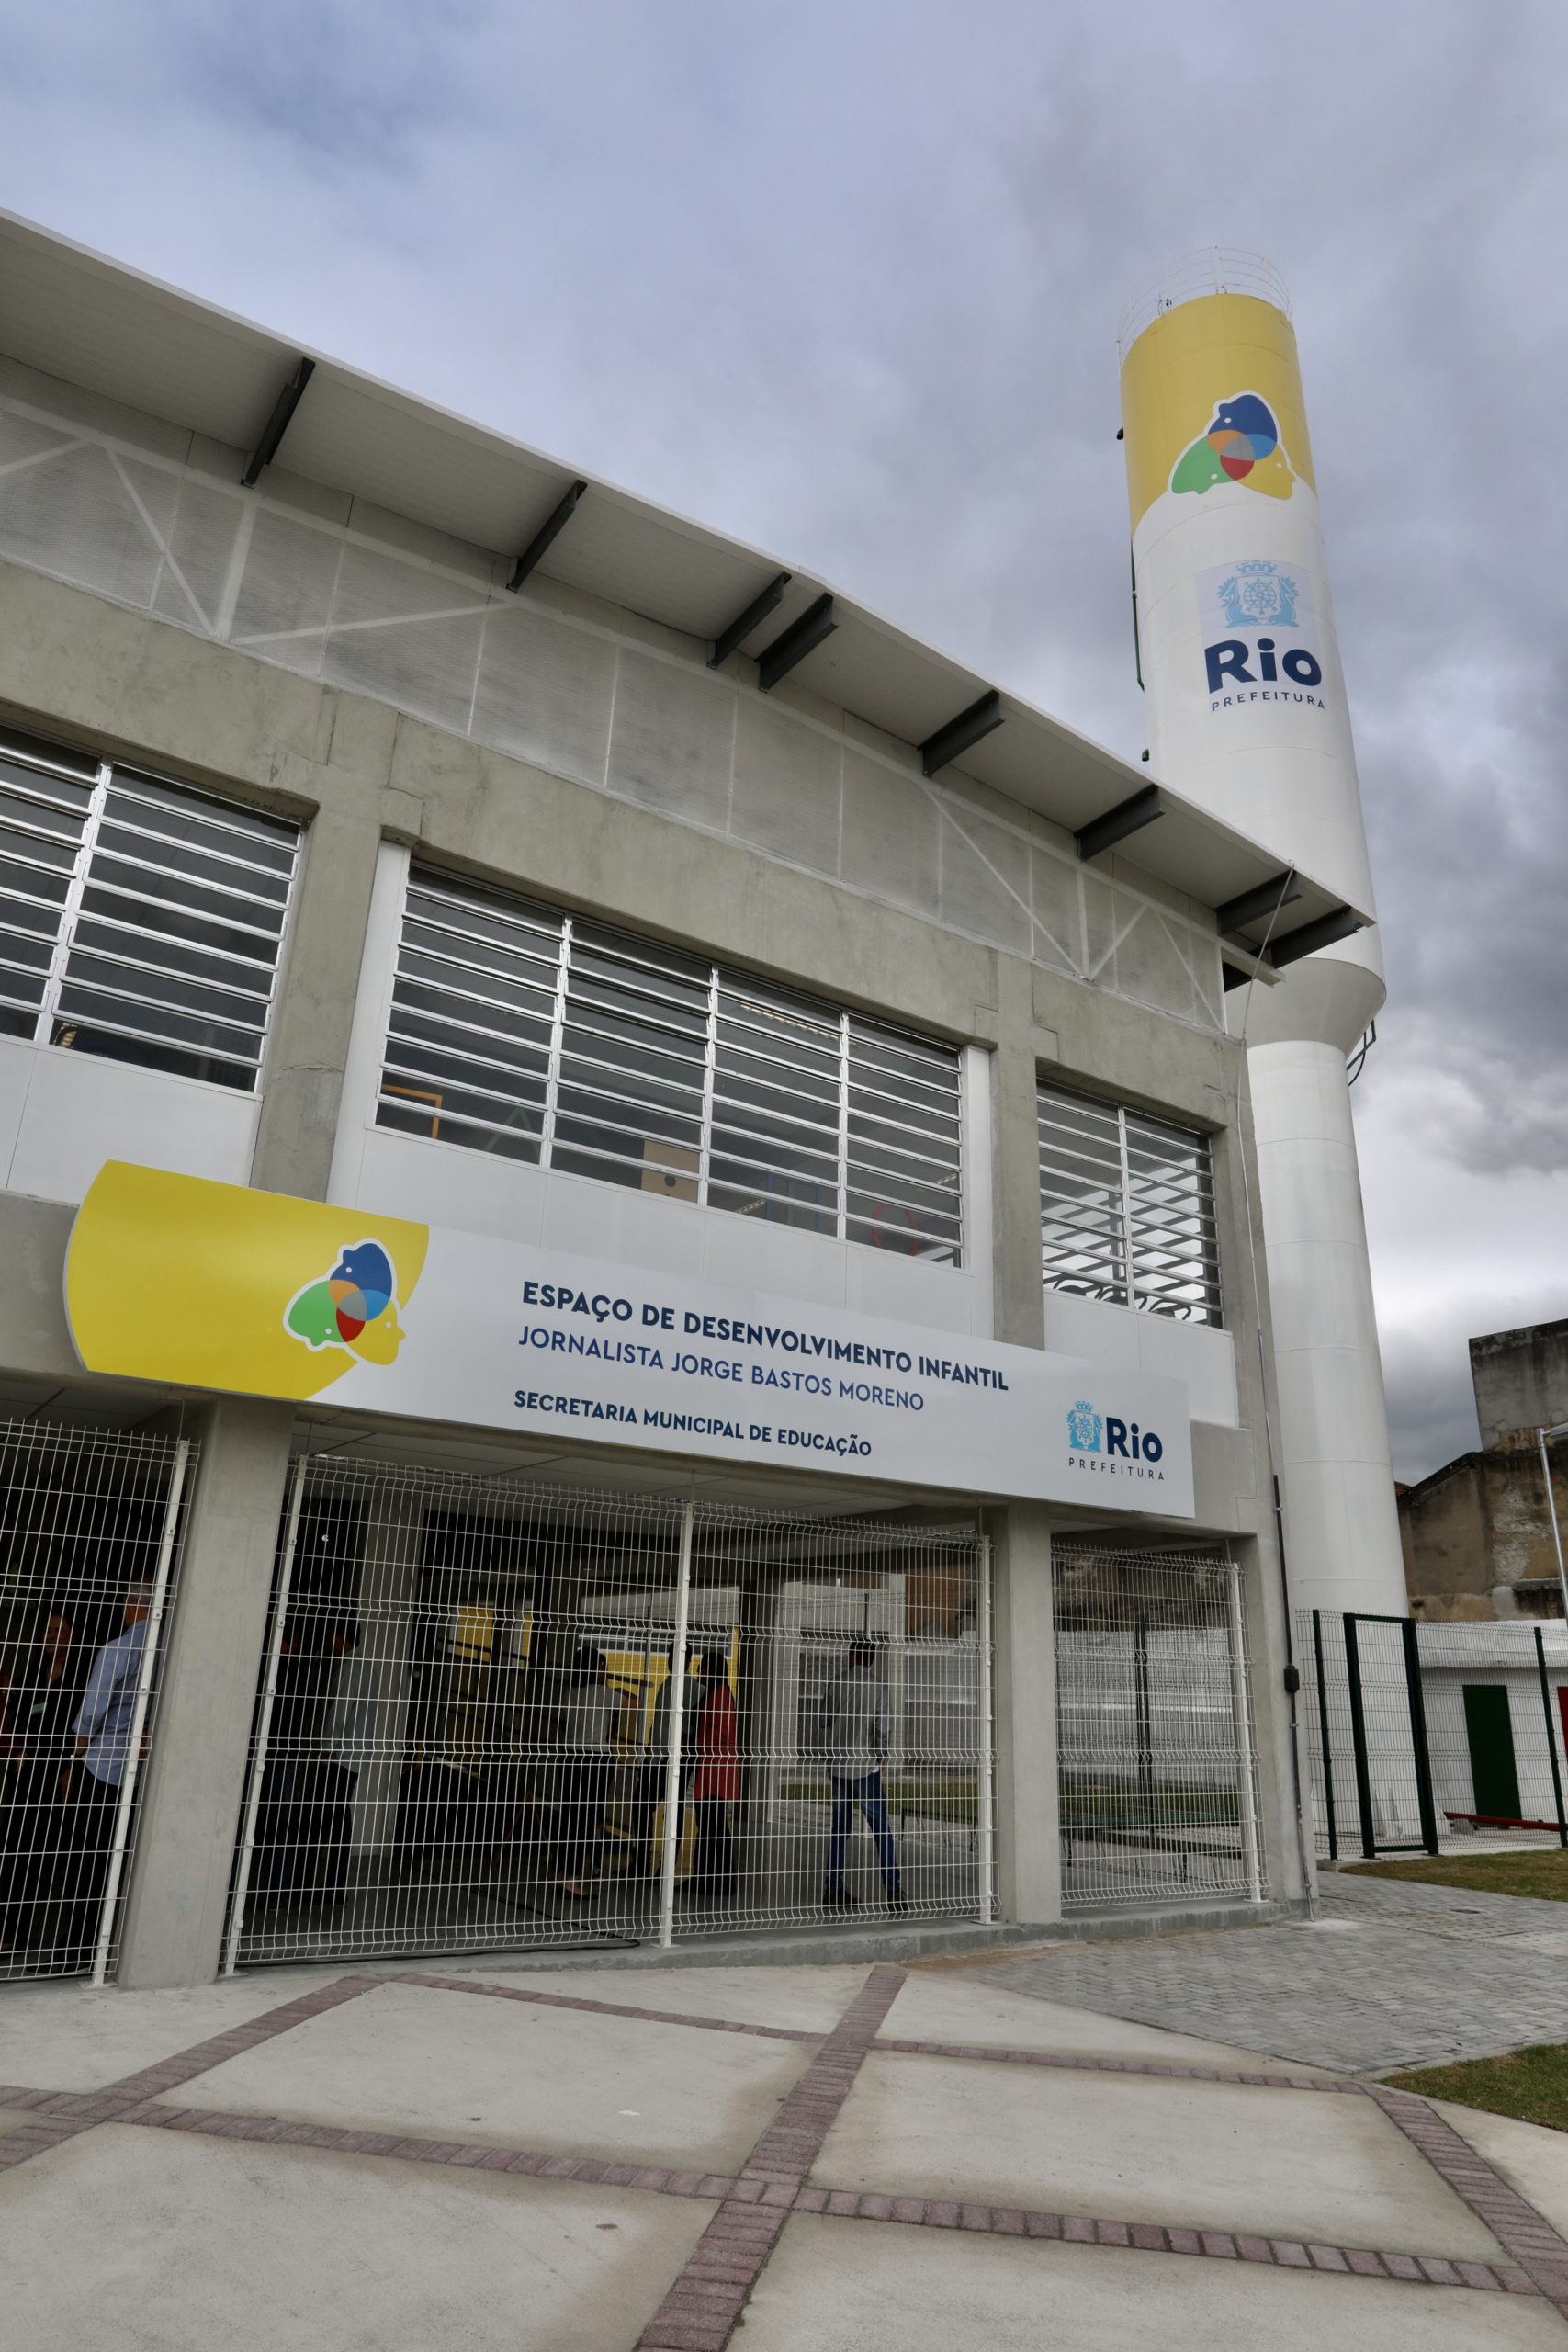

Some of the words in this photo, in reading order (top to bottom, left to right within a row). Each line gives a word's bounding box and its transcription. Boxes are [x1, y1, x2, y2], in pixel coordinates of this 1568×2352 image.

[1204, 638, 1323, 695] Rio
[1212, 691, 1325, 712] PREFEITURA
[523, 1281, 632, 1322] ESPAÇO
[642, 1304, 675, 1330] DE
[684, 1312, 912, 1373] DESENVOLVIMENTO
[919, 1356, 1010, 1392] INFANTIL
[519, 1325, 663, 1369] JORNALISTA
[671, 1352, 743, 1383] JORGE
[752, 1365, 832, 1396] BASTOS
[840, 1381, 924, 1411] MORENO
[514, 1390, 637, 1424] SECRETARIA
[644, 1409, 745, 1440] MUNICIPAL
[750, 1425, 773, 1443] DE
[778, 1429, 872, 1456] EDUCAÇÃO
[1106, 1417, 1163, 1464] Rio
[1068, 1457, 1165, 1481] PREFEITURA
